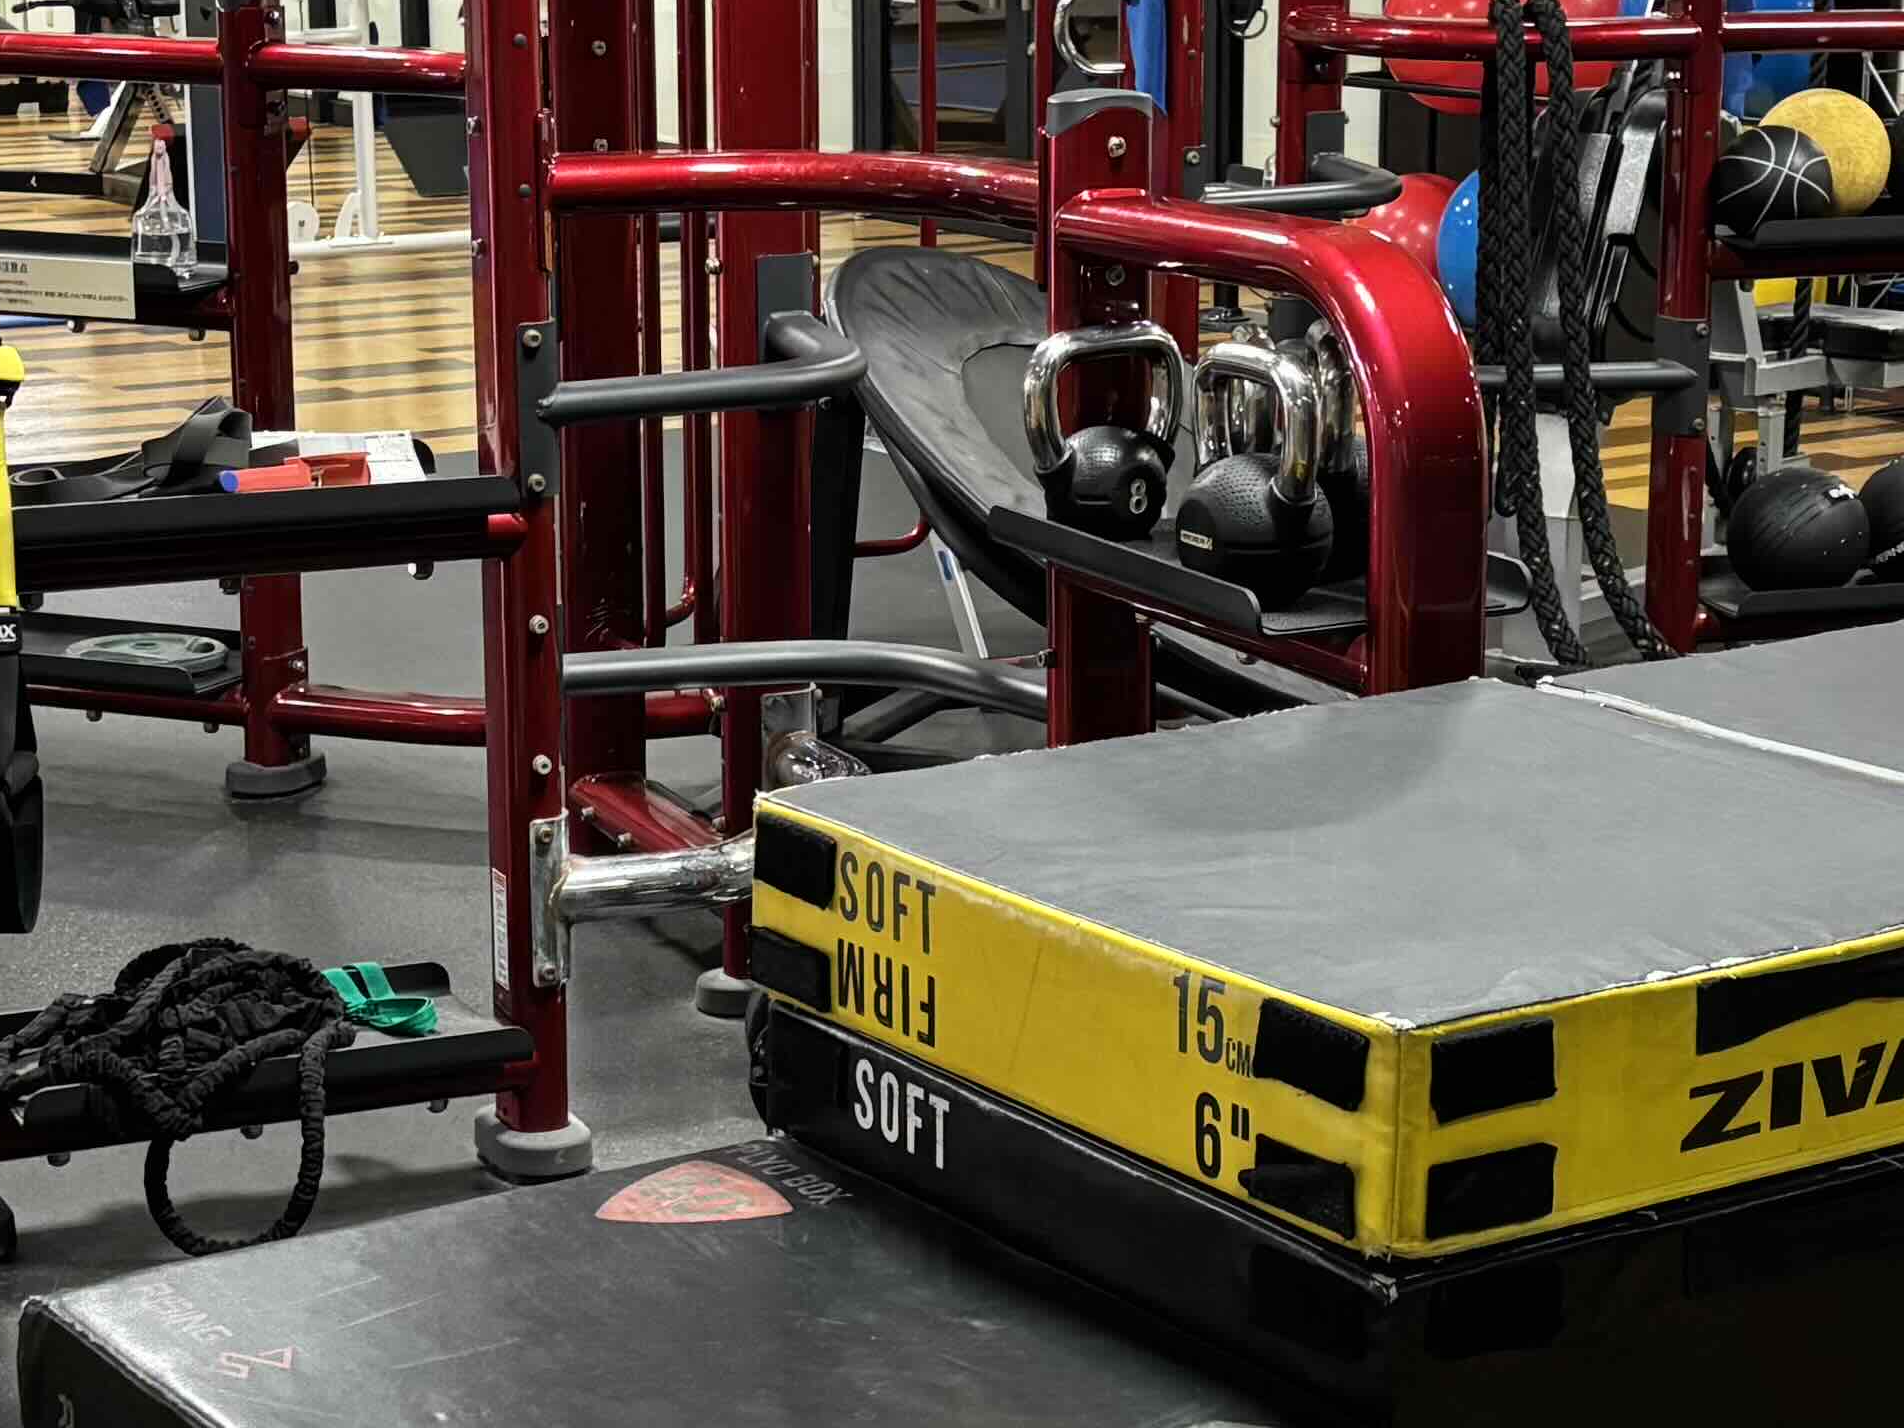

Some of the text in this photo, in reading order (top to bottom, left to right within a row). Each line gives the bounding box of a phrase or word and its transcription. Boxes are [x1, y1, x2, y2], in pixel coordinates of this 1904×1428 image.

[1129, 478, 1148, 514] 8
[839, 850, 938, 956] SOFT
[836, 937, 938, 1049] FIRM
[852, 1057, 950, 1170] SOFT
[781, 1173, 854, 1206] BOX
